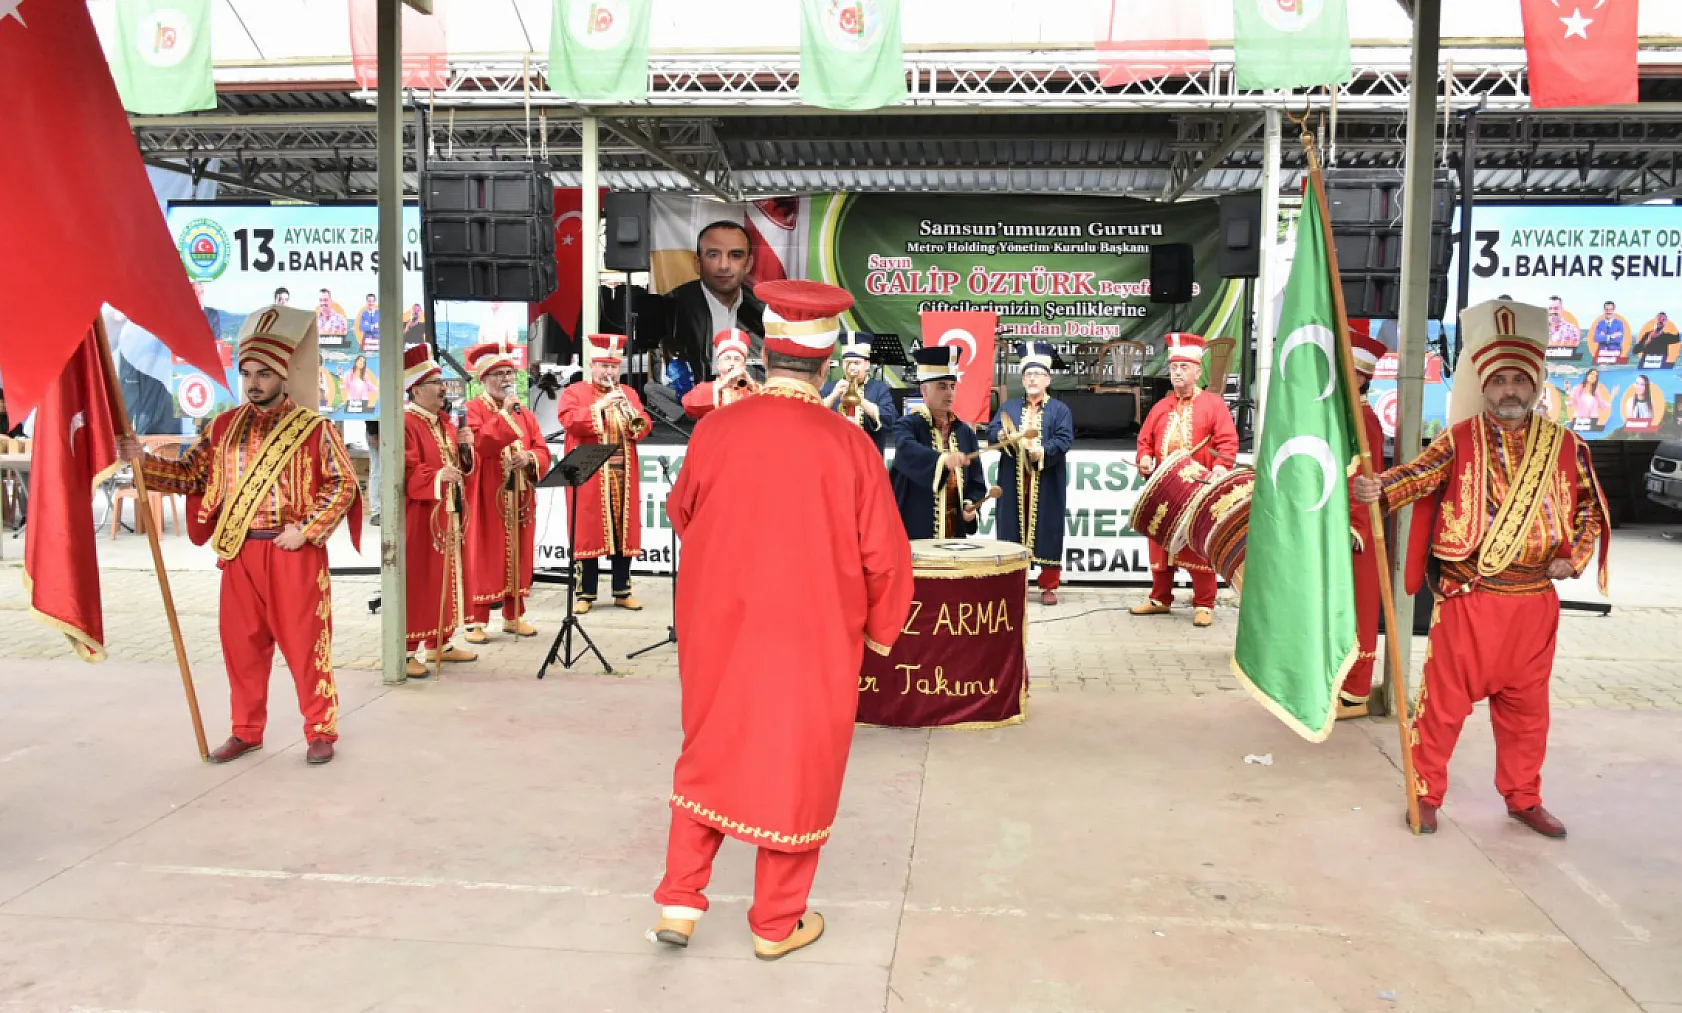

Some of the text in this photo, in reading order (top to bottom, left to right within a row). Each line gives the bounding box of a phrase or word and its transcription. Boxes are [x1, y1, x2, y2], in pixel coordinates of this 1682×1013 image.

[284, 227, 346, 245] AYVACIK
[1087, 222, 1164, 237] Gururu
[1511, 229, 1584, 248] AYVACIK
[906, 240, 1150, 256] Metro Holding Yönetim Kurulu Başkanı
[288, 250, 364, 272] BAHAR
[868, 254, 913, 272] Sayın
[1515, 254, 1604, 278] BAHAR
[865, 265, 961, 296] GALİP
[966, 265, 1097, 296] ÖZTÜRK
[1045, 301, 1148, 320] Şenliklerine
[1064, 320, 1121, 340] Dolayı
